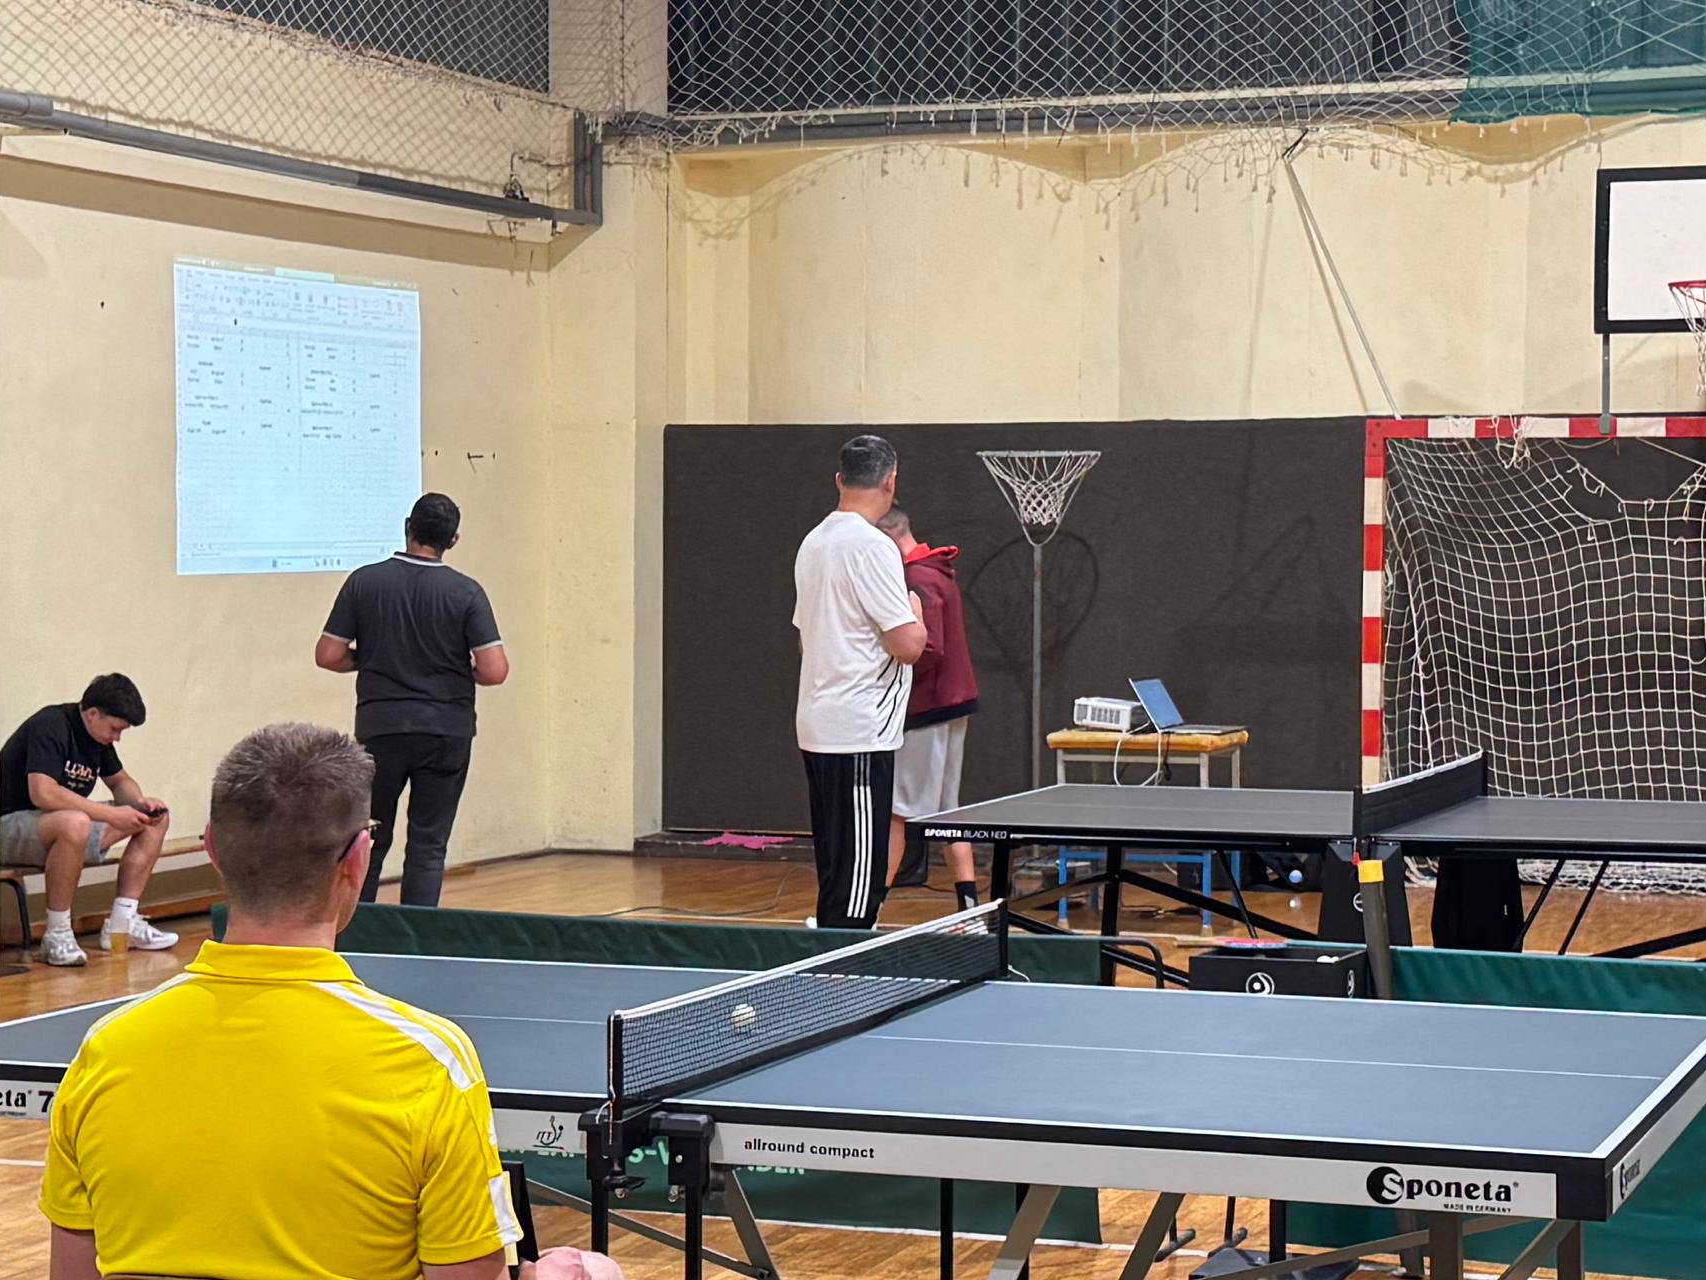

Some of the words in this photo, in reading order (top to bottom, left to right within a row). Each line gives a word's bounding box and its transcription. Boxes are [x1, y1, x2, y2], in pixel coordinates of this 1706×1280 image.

[744, 1138, 805, 1154] allround
[809, 1145, 875, 1159] compact
[1366, 1166, 1512, 1205] Sponeta
